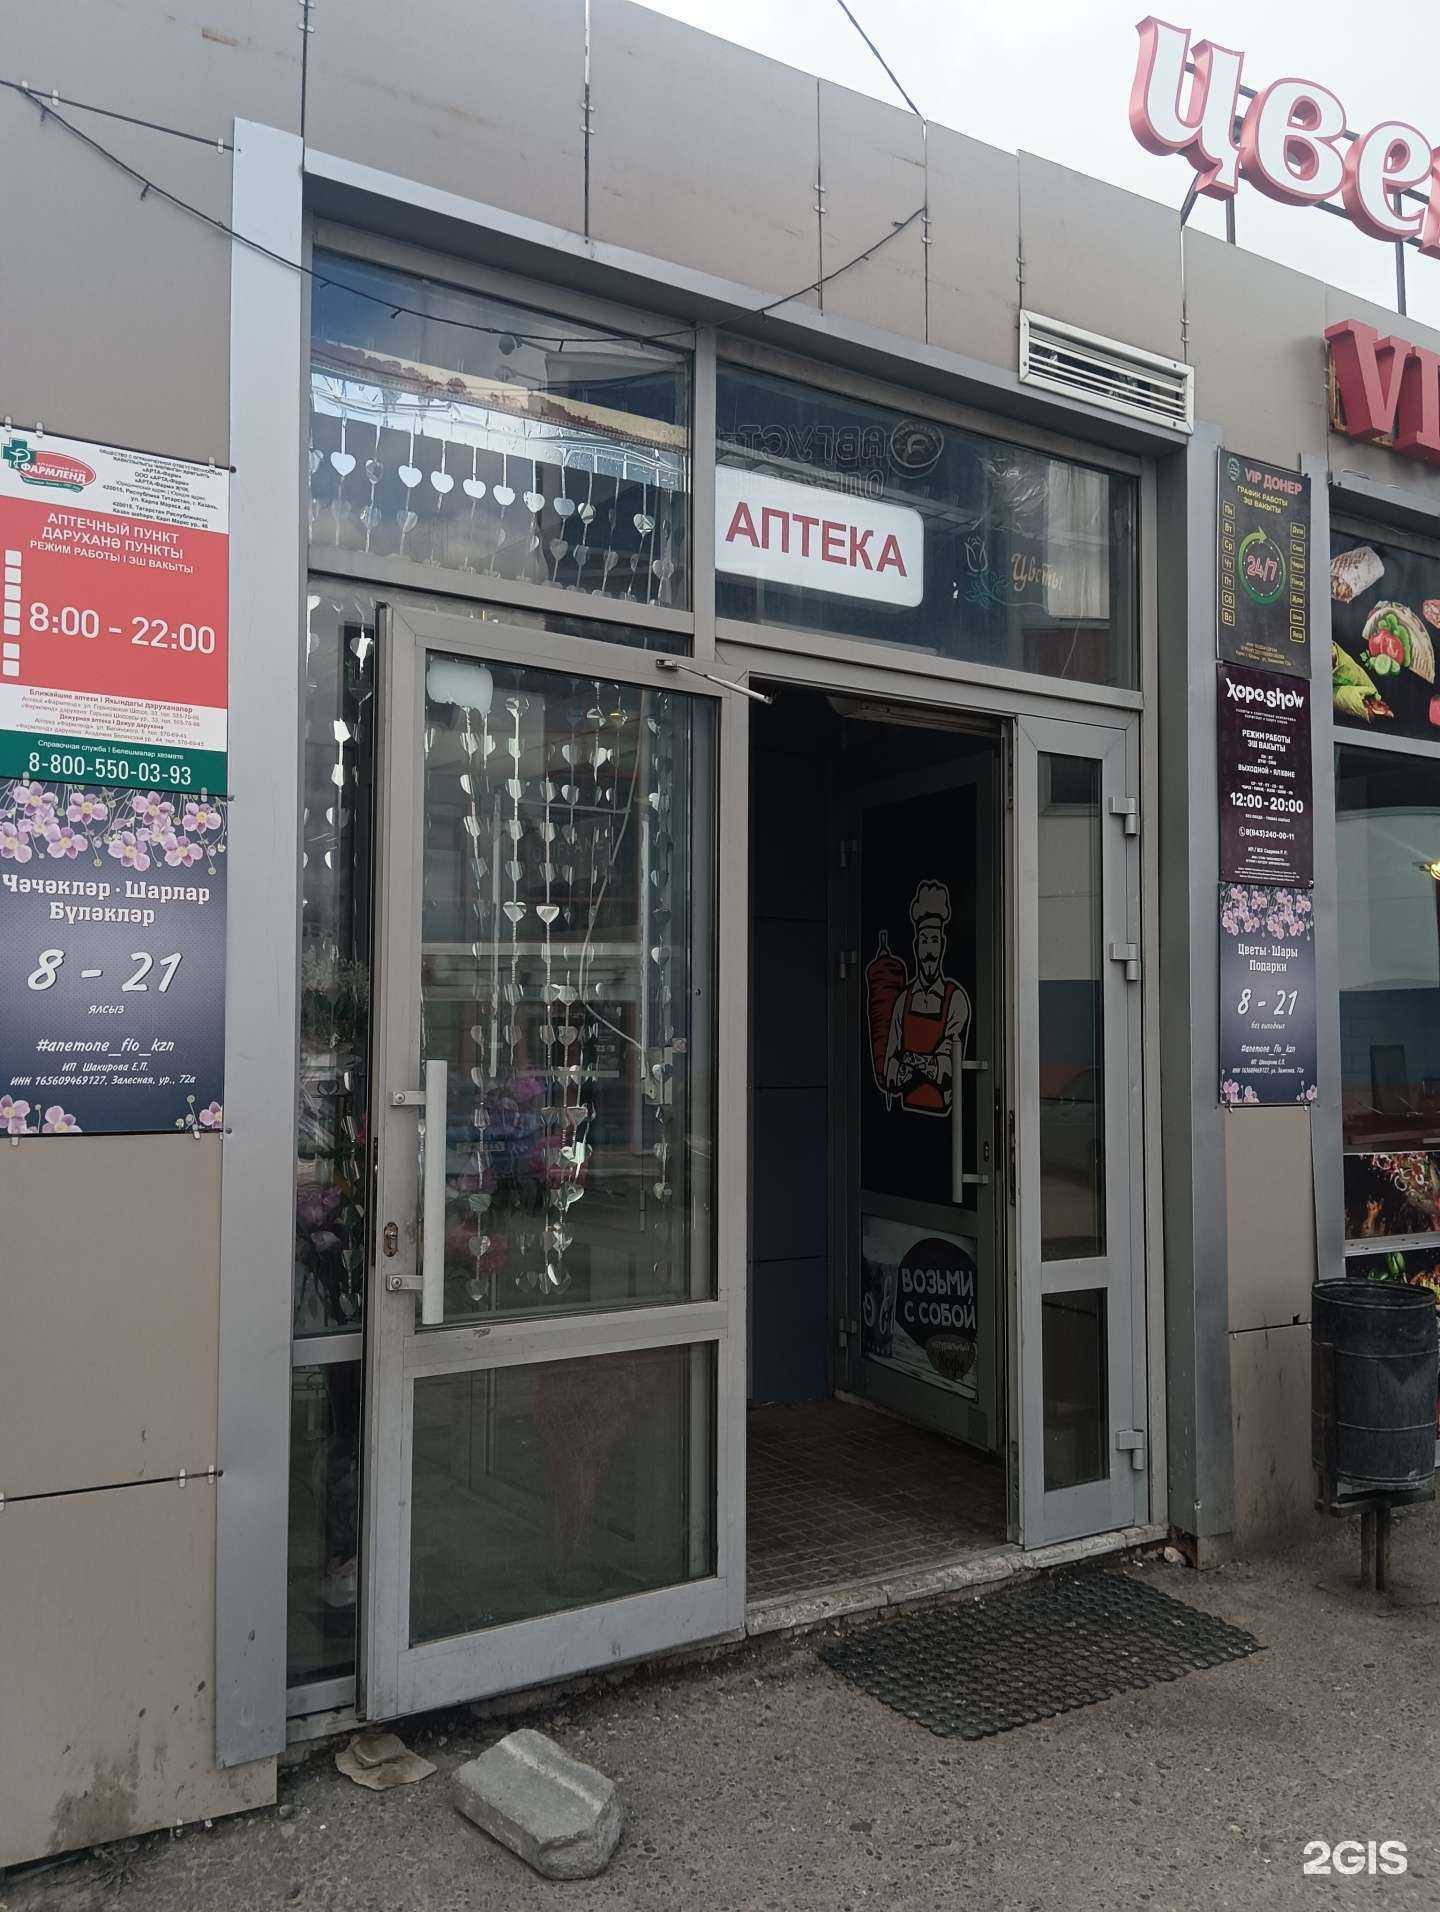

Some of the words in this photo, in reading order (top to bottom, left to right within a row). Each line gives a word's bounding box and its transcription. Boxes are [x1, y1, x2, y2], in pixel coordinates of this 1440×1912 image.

[1128, 15, 1440, 259] Цве
[21, 462, 87, 484] ФАРМЛЕНД
[135, 471, 149, 479] ООО
[1263, 473, 1302, 496] ДОНЕР
[1237, 485, 1261, 499] ГРАФИК
[1262, 493, 1288, 507] РАБОТЫ
[47, 512, 131, 535] АПТЕЧНЫЙ
[134, 526, 180, 545] ПУНКТ
[725, 501, 908, 578] АПТЕКА
[41, 526, 121, 549] ДАРУХАНӘ
[125, 539, 184, 560] ПУНКТЫ
[29, 540, 71, 554] РЕЖИМ
[74, 547, 120, 563] РАБОТЫ
[129, 556, 146, 567] ЭШ
[148, 559, 194, 574] ВАКЫТЫ
[1247, 555, 1277, 582] 24/7
[29, 601, 100, 639] 8:00
[130, 616, 216, 655] 22:00
[29, 688, 73, 701] Ближайшие
[74, 693, 99, 704] аптеки
[37, 739, 80, 750] Справочная
[81, 744, 107, 754] служба
[1242, 729, 1265, 740] РЕЖИМ
[1265, 733, 1291, 744] РАБОТЫ
[1247, 739, 1258, 748] ЭШ
[1258, 741, 1286, 752] ВАКЫТЫ
[29, 751, 192, 785] 8-800-550-03-93
[1237, 764, 1269, 774] ВЫХОДНОЙ
[1230, 791, 1263, 809] 12:00
[1269, 796, 1304, 814] 20:00
[2, 873, 111, 900] Чәчәкләр
[125, 880, 210, 905] Шарлар
[49, 901, 155, 927] Бүләкләр
[1237, 943, 1267, 957] Цветы
[1271, 945, 1298, 960] Шары
[27, 948, 66, 991] 8
[121, 951, 183, 993] 21
[1249, 959, 1287, 974] Подарки
[1237, 988, 1252, 1015] 8
[1273, 989, 1298, 1016] 21
[36, 1037, 175, 1057] #anemone_flo_kzn
[62, 1062, 77, 1071] ИП
[82, 1061, 129, 1073] Шакирова
[131, 1061, 148, 1071] Е.П.
[10, 1076, 33, 1086] ИНН
[35, 1075, 109, 1086] 165609469127,
[111, 1074, 156, 1085] Залесная,
[179, 1074, 196, 1084] 72а
[901, 1267, 975, 1298] ВОЗЬМИ
[904, 1301, 915, 1323] С
[918, 1298, 976, 1329] СОБОЙ
